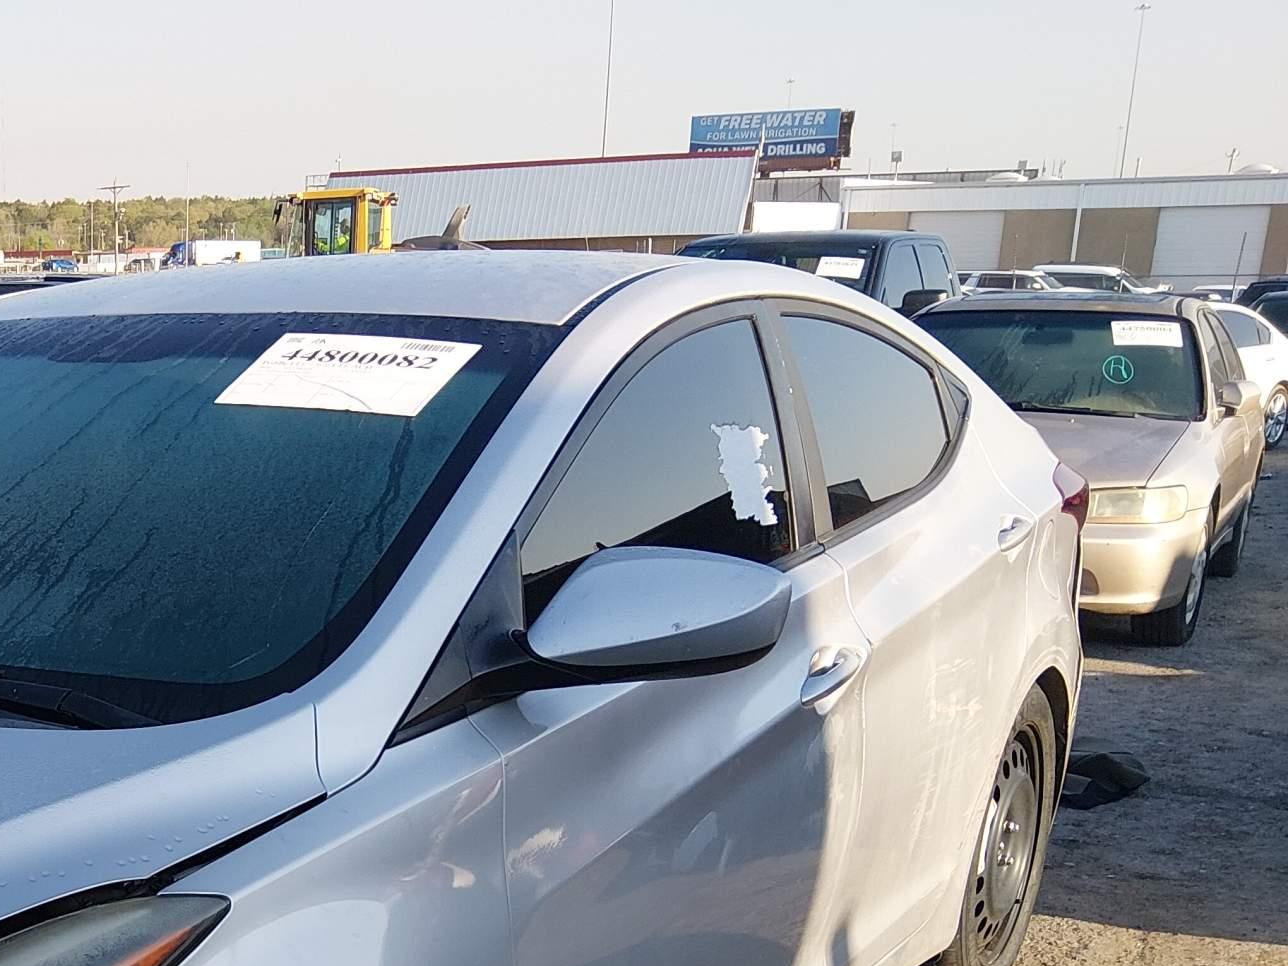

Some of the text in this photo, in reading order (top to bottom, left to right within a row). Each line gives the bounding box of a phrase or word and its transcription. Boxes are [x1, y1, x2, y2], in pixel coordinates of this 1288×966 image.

[700, 111, 826, 129] GET FREE WATER
[707, 130, 726, 140] FOR
[728, 130, 756, 140] LAWN
[767, 143, 825, 156] DRILLING
[280, 348, 438, 369] 44800082
